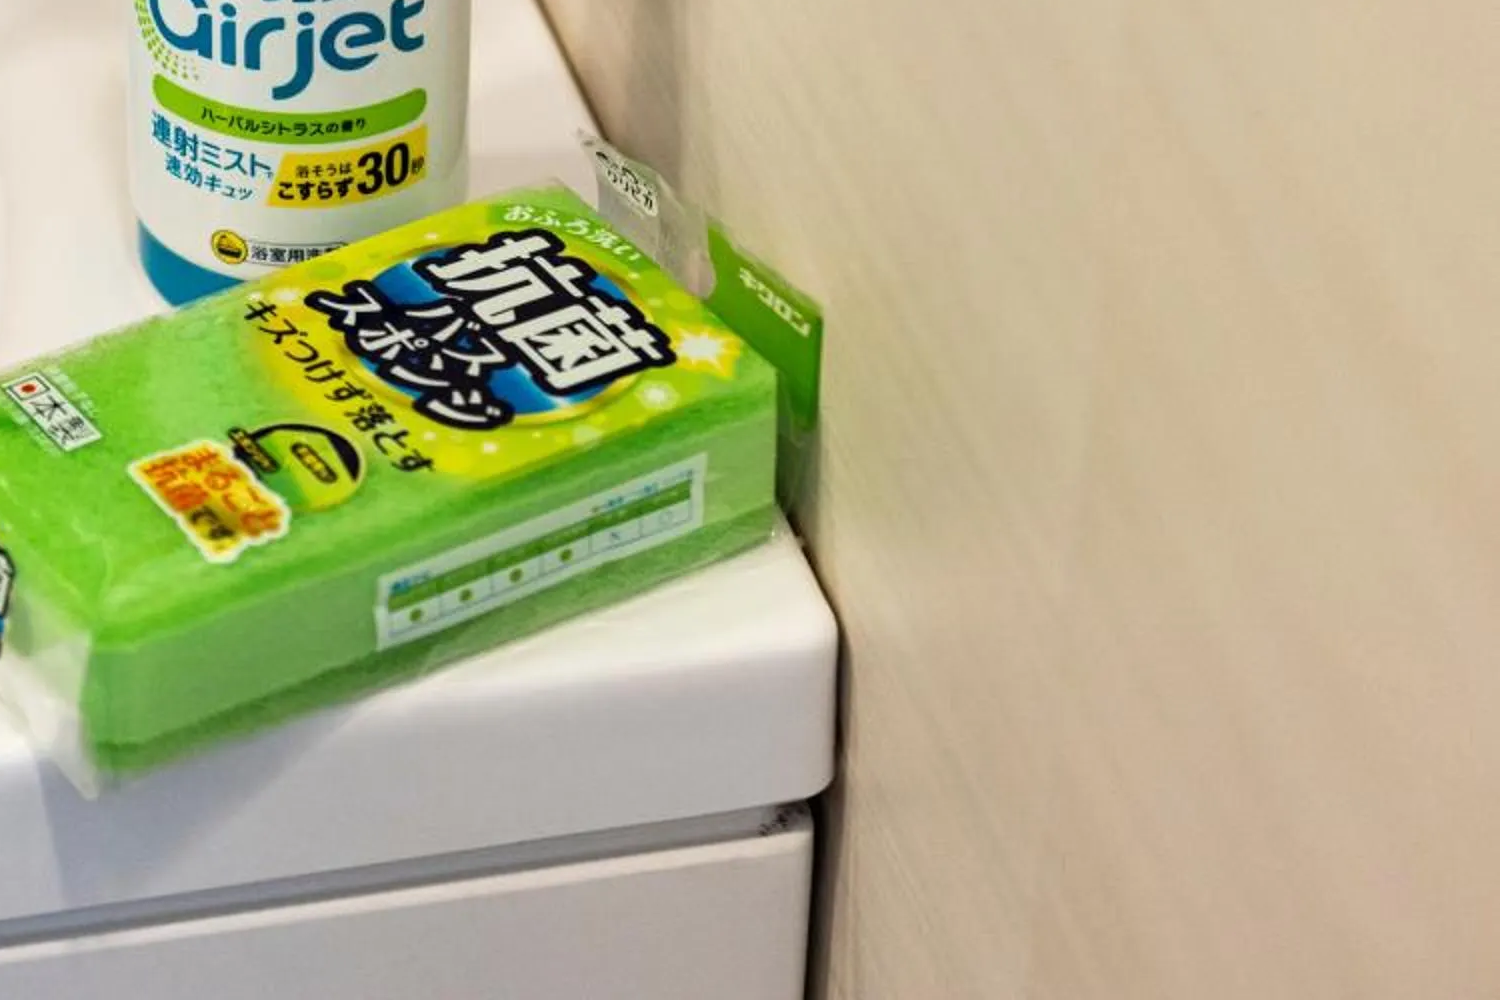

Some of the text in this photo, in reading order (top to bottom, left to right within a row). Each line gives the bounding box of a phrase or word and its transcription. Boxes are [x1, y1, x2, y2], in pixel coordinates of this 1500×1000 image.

[201, 106, 366, 138] ハーバルシトラスの香り
[250, 243, 342, 263] 浴室用洗
[503, 203, 642, 262] おふろ洗い
[406, 303, 507, 377] バス
[420, 232, 670, 392] 抗菌
[244, 300, 436, 472] キズつけず落とす
[315, 286, 507, 425] スポンジ
